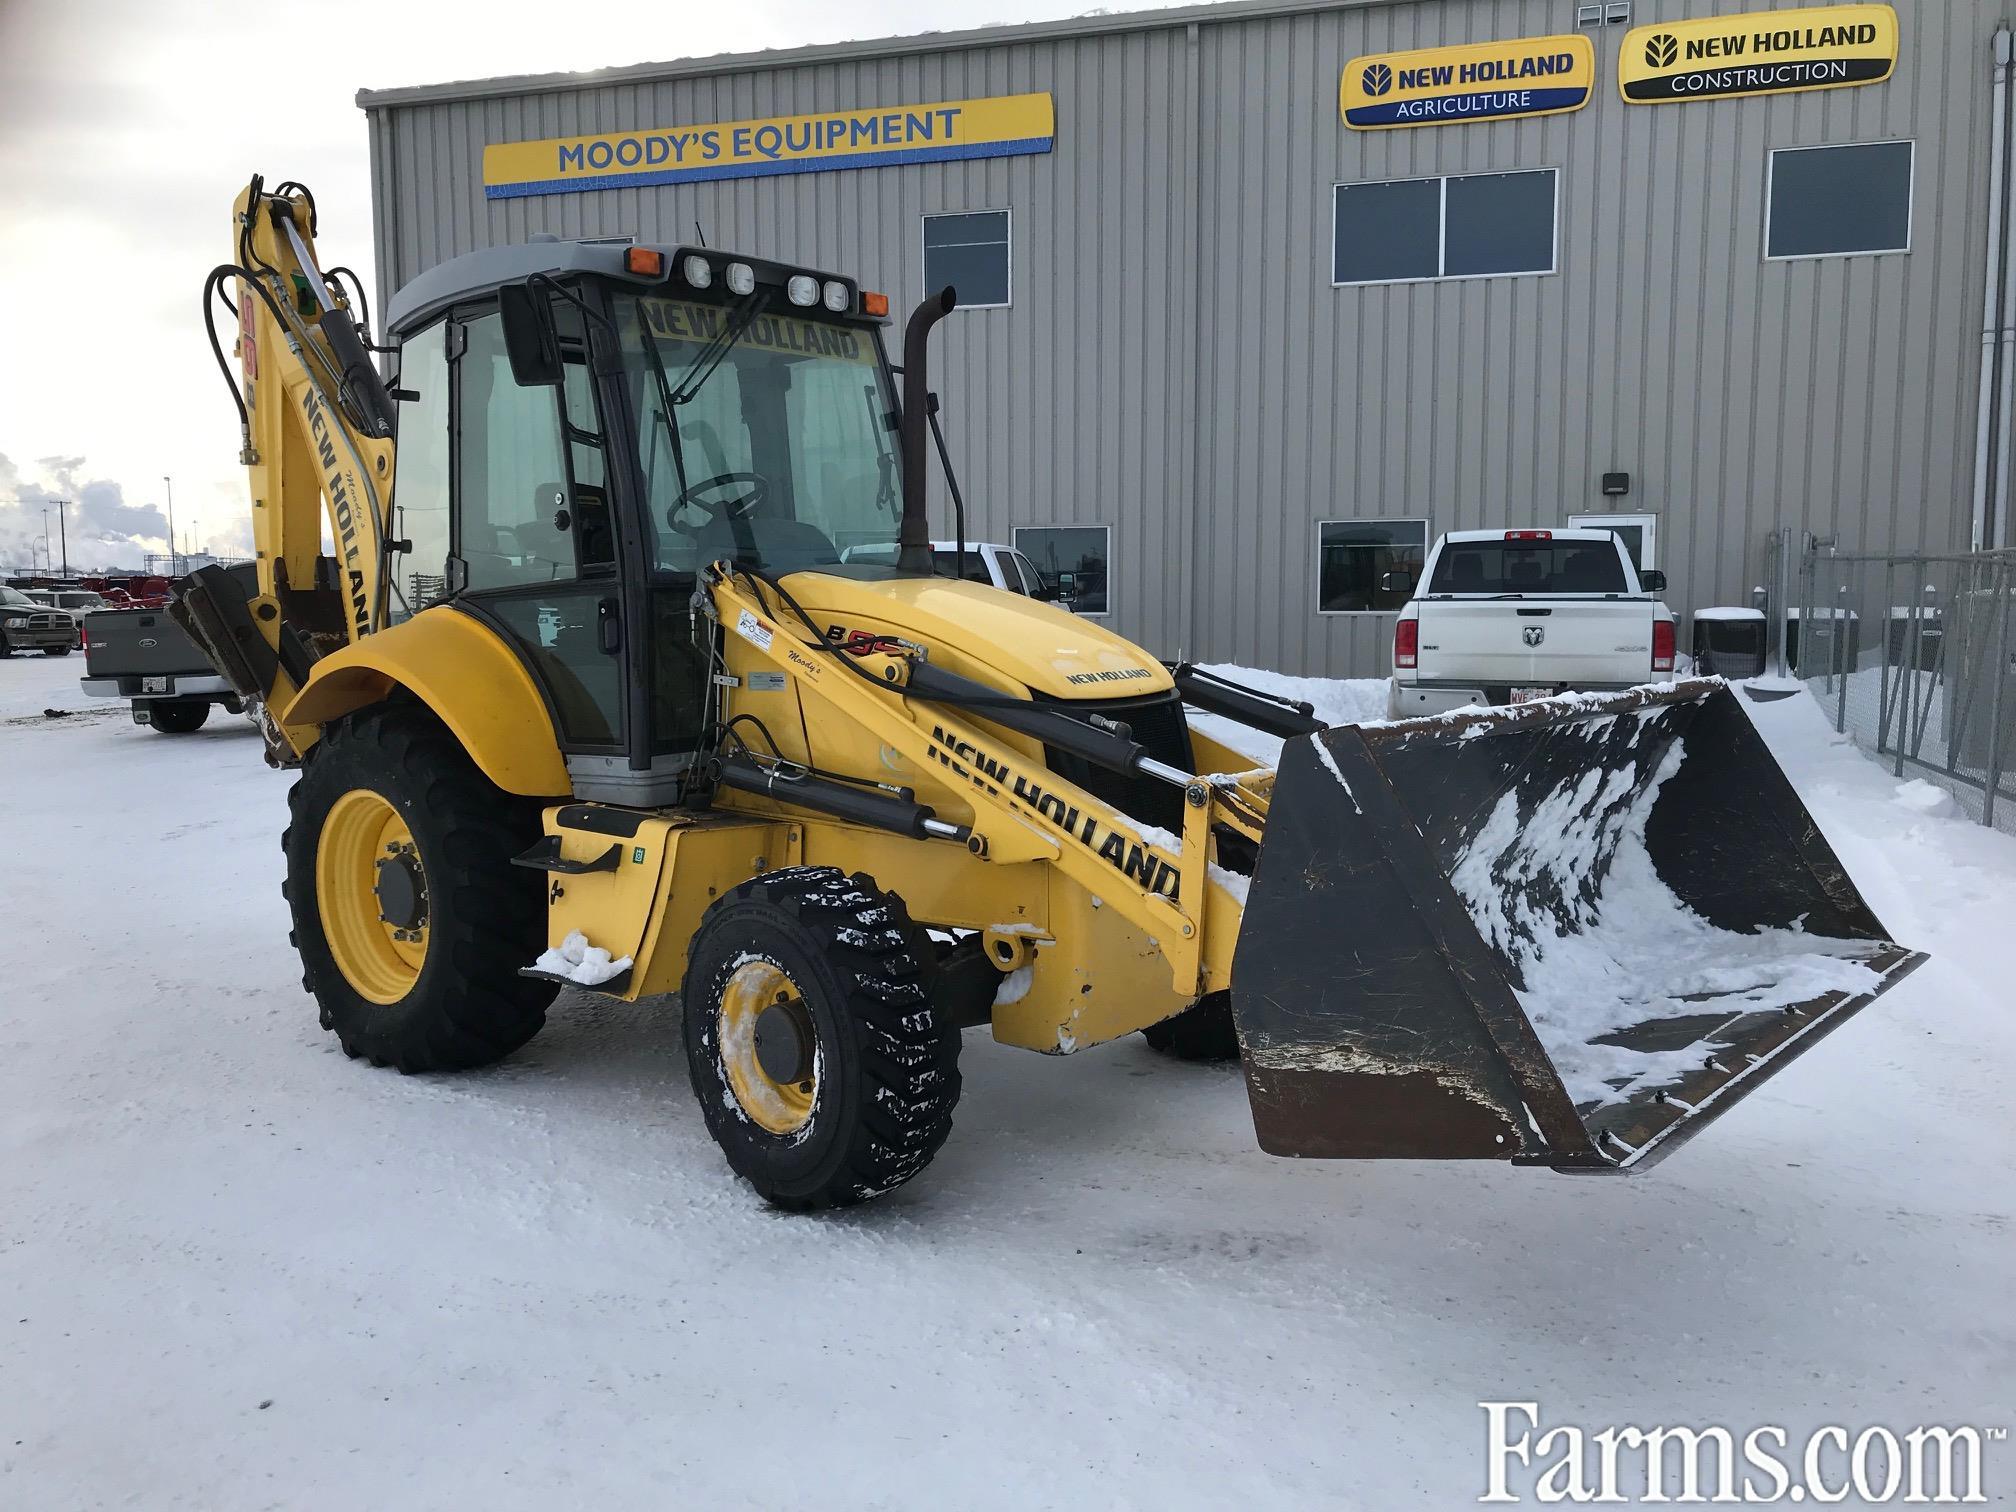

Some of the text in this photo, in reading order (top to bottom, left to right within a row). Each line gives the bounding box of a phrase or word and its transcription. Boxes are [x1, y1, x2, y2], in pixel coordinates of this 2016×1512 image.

[1686, 23, 1876, 60] NEW HOLLAND
[1398, 53, 1574, 90] NEW HOLLAND
[1671, 60, 1847, 92] CONSTRUCTION
[1396, 91, 1531, 118] AGRICULTURE
[558, 108, 962, 173] MOODY'S EQUIPMENT
[302, 387, 336, 471] NEW
[1066, 668, 1152, 685] NEW HOLLAND
[926, 725, 1182, 904] NEW HOLLAND
